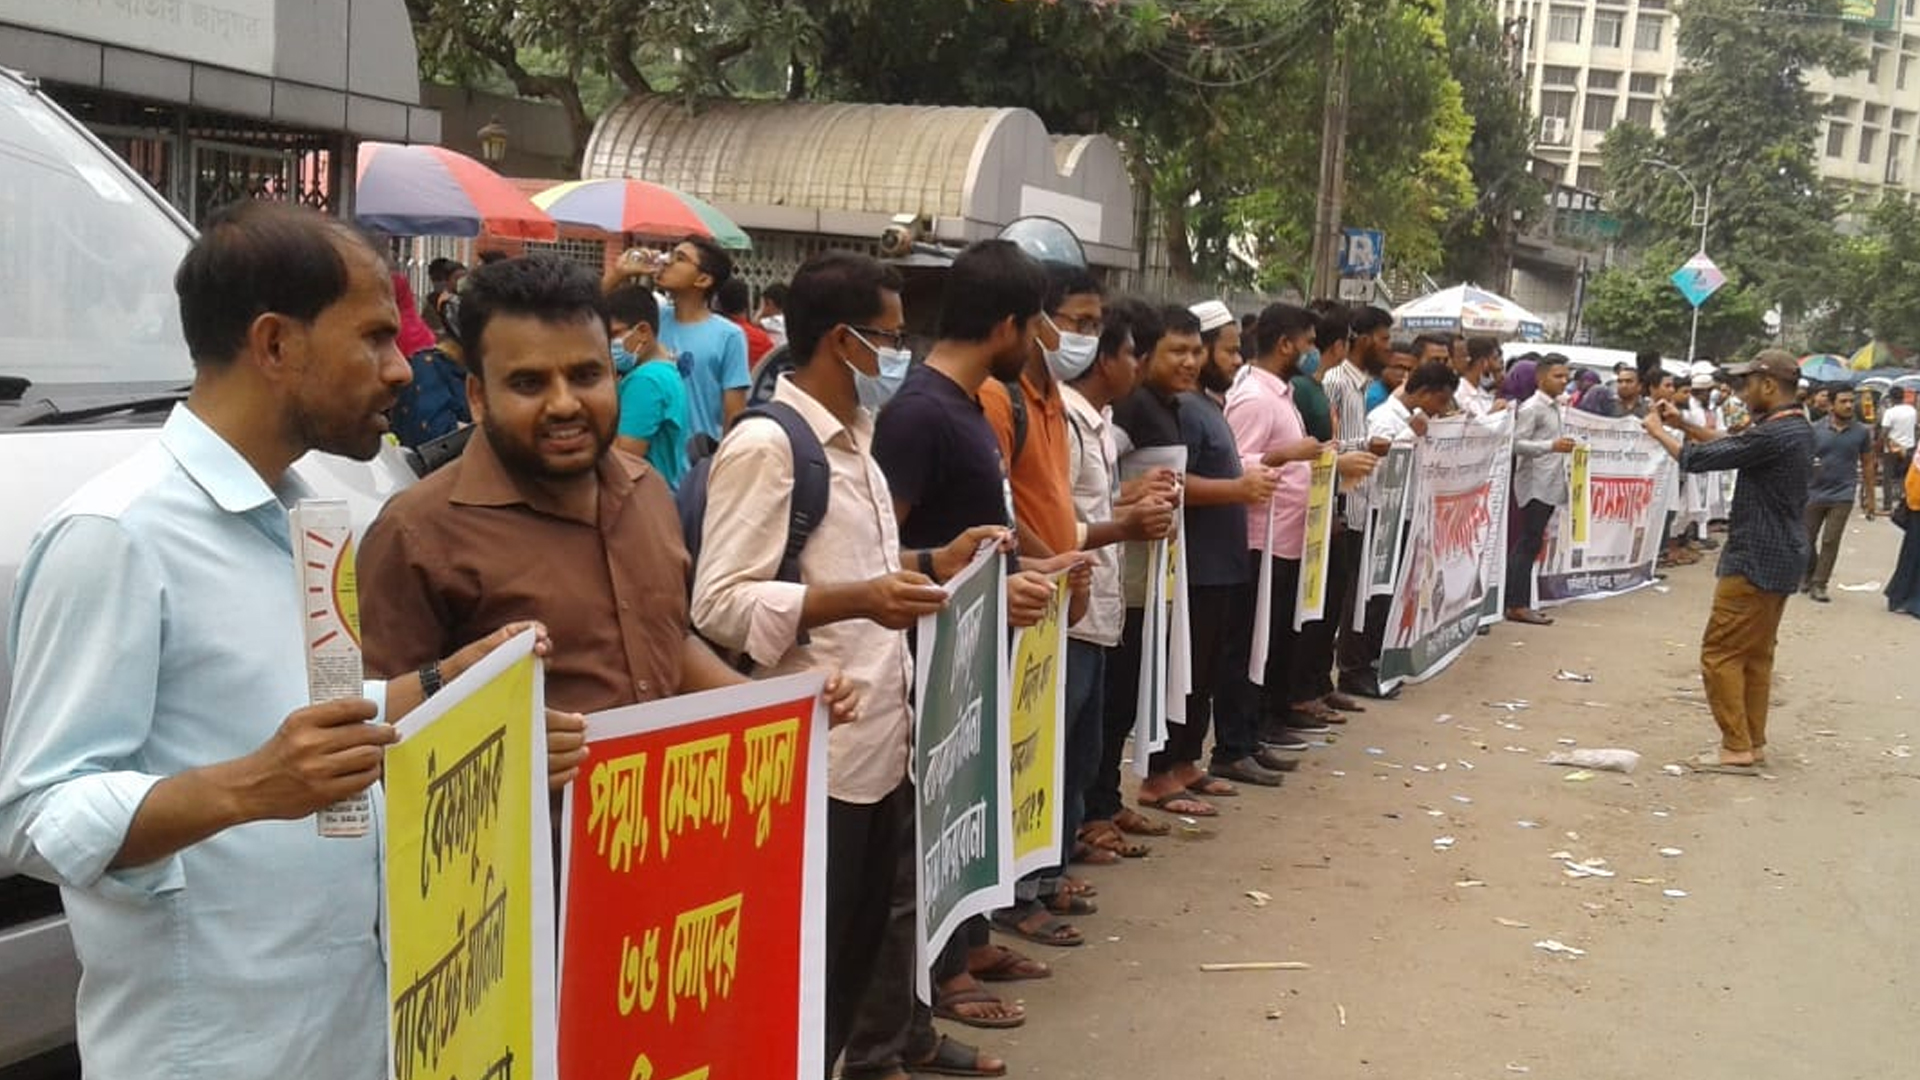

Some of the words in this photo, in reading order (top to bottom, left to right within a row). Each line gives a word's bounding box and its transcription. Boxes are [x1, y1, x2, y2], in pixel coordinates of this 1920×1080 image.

[587, 752, 648, 873] পদ্মা,
[660, 733, 732, 862] মেঘনা,
[742, 717, 800, 849] যমুনা
[618, 926, 660, 1017] ৩৫
[668, 893, 743, 1025] মোদের
